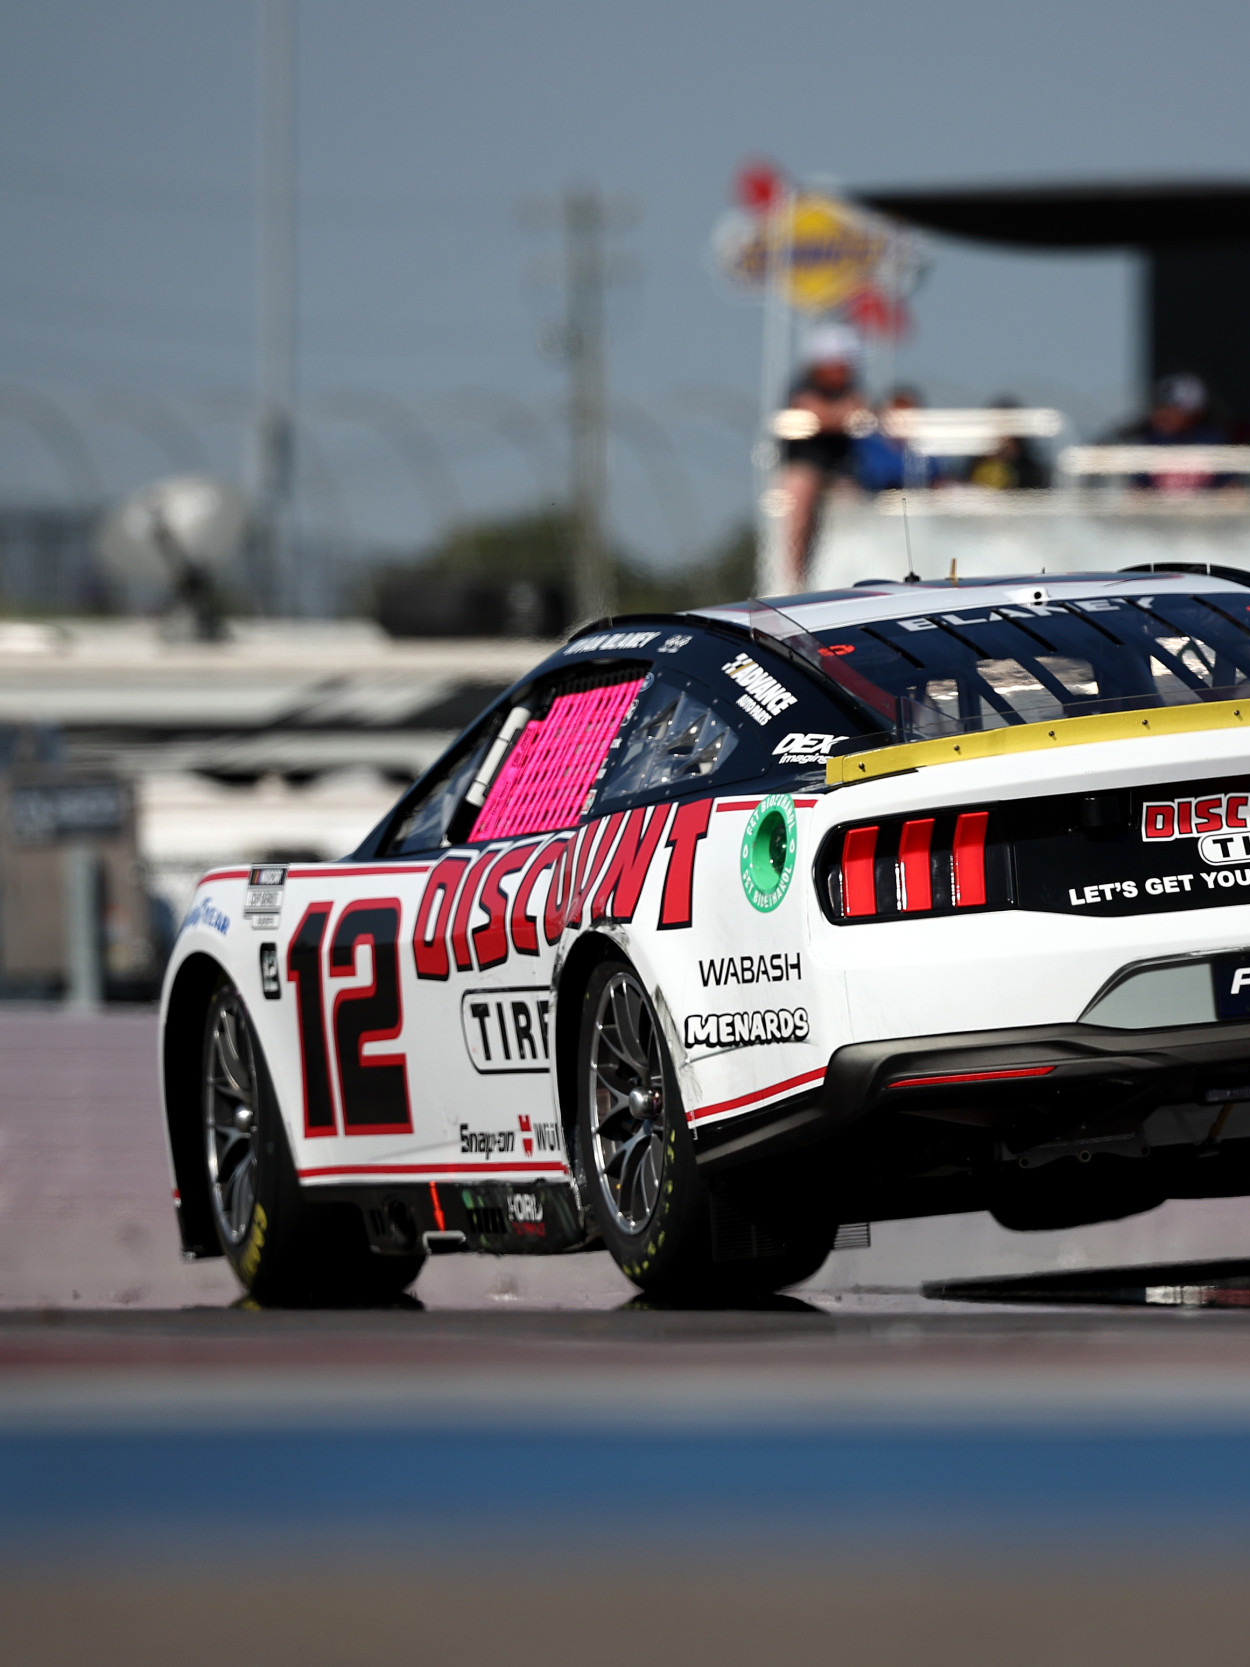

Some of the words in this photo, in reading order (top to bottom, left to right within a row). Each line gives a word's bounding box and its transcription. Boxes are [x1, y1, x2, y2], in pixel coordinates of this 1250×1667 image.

[730, 662, 798, 716] ADVANCE
[772, 733, 849, 756] DEX
[746, 809, 760, 836] GET
[412, 797, 715, 982] DISCOUNT
[743, 869, 755, 894] GET
[1145, 874, 1194, 896] GET
[698, 952, 802, 987] WABASH
[287, 897, 414, 1138] 12
[684, 1007, 810, 1049] MENARDS
